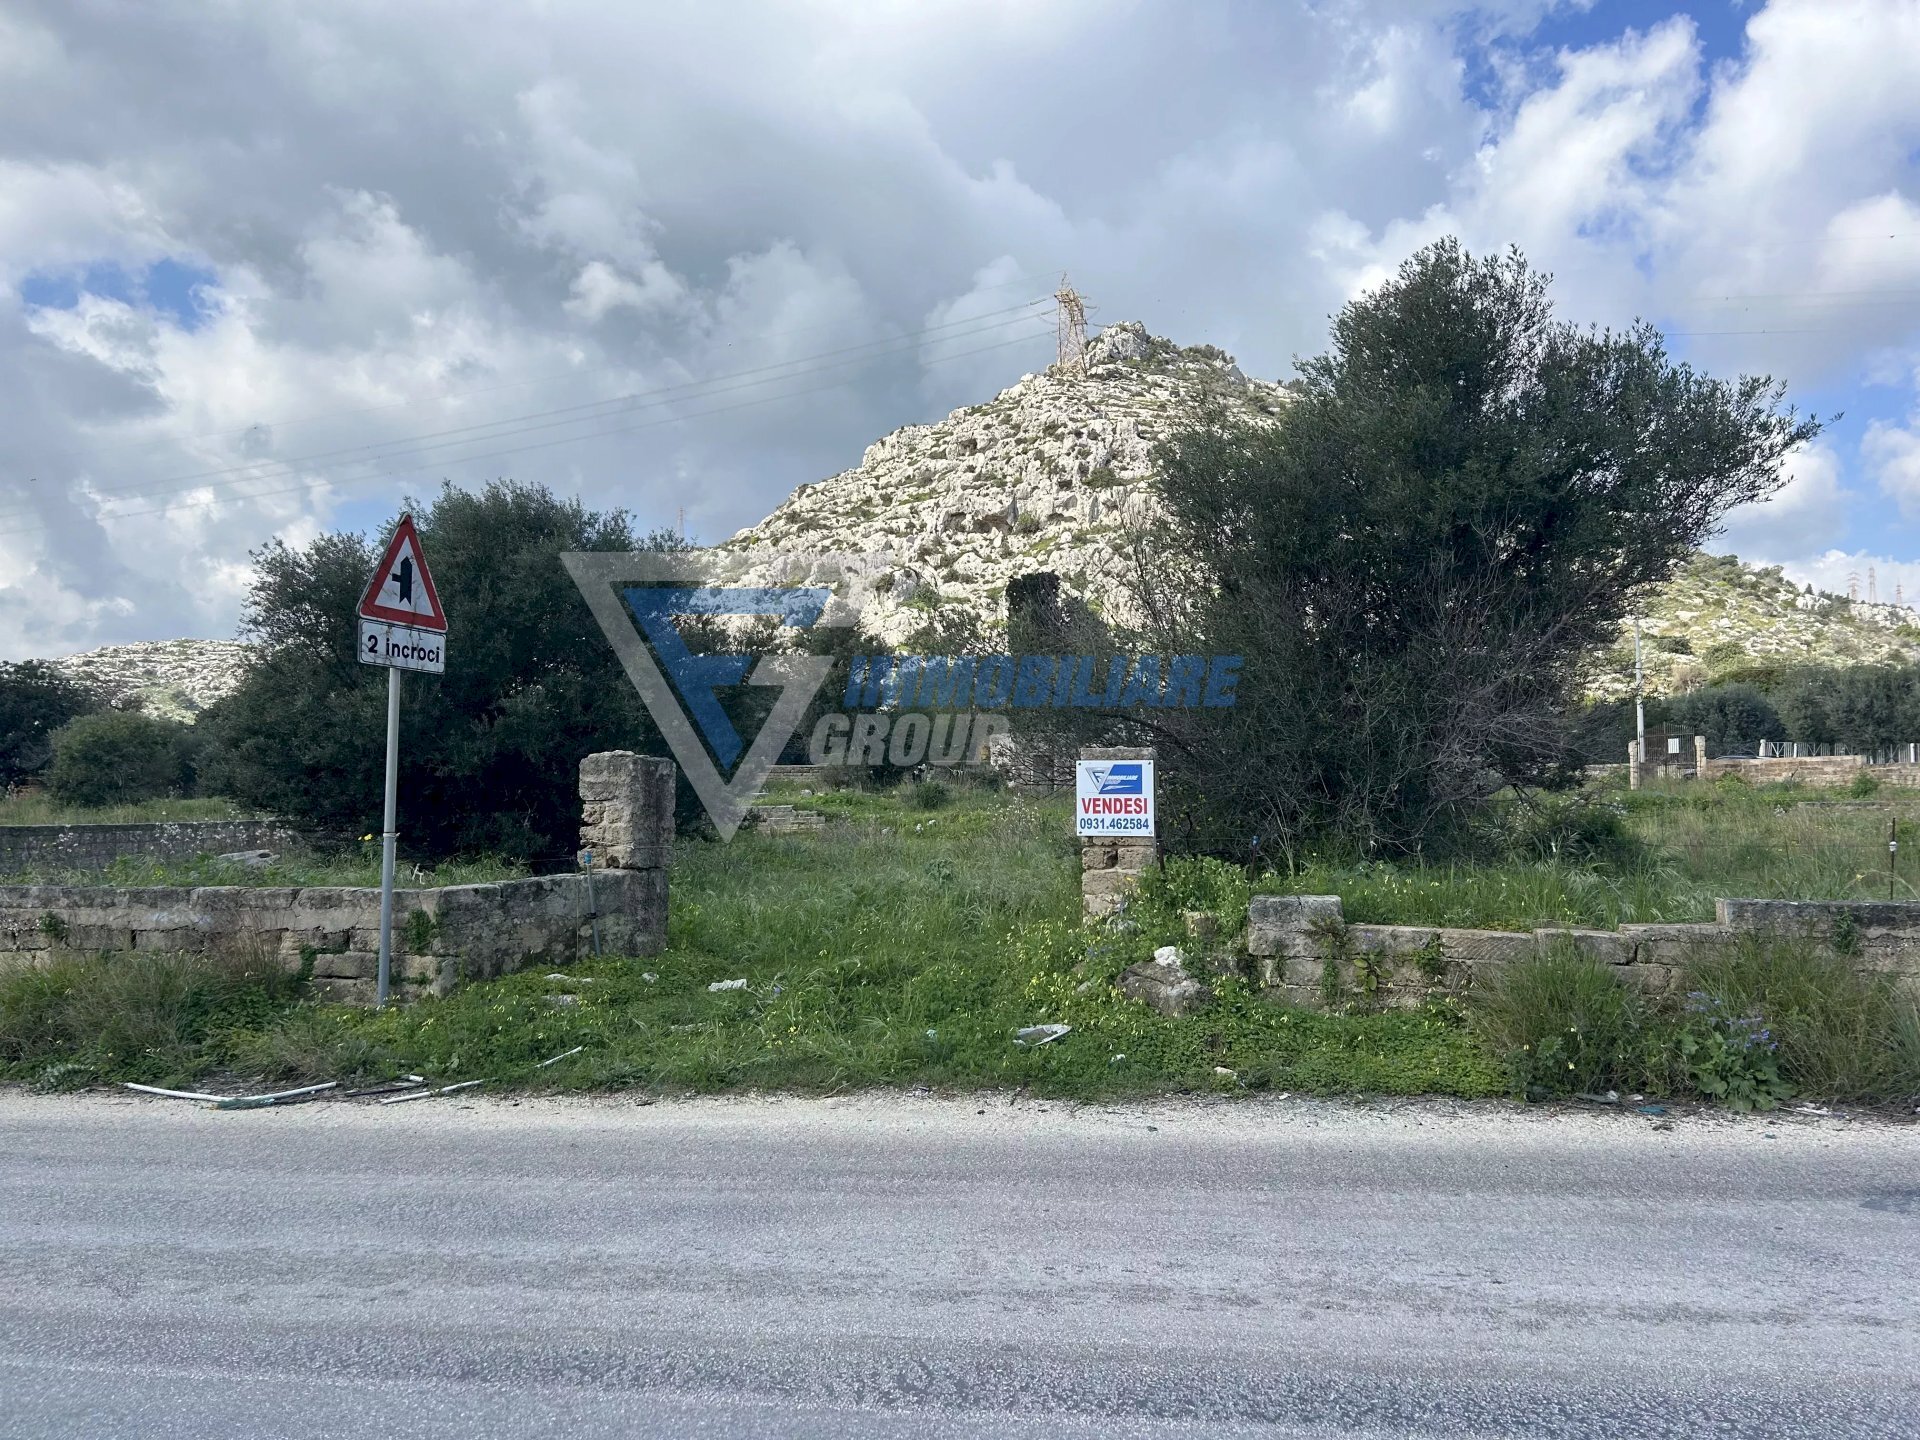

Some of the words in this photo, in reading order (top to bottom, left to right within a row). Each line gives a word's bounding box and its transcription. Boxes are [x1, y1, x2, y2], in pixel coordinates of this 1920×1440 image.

[367, 634, 378, 653] 2
[386, 637, 440, 663] incroci
[1081, 798, 1148, 814] VENDESI
[1080, 818, 1149, 829] 0931.462584
